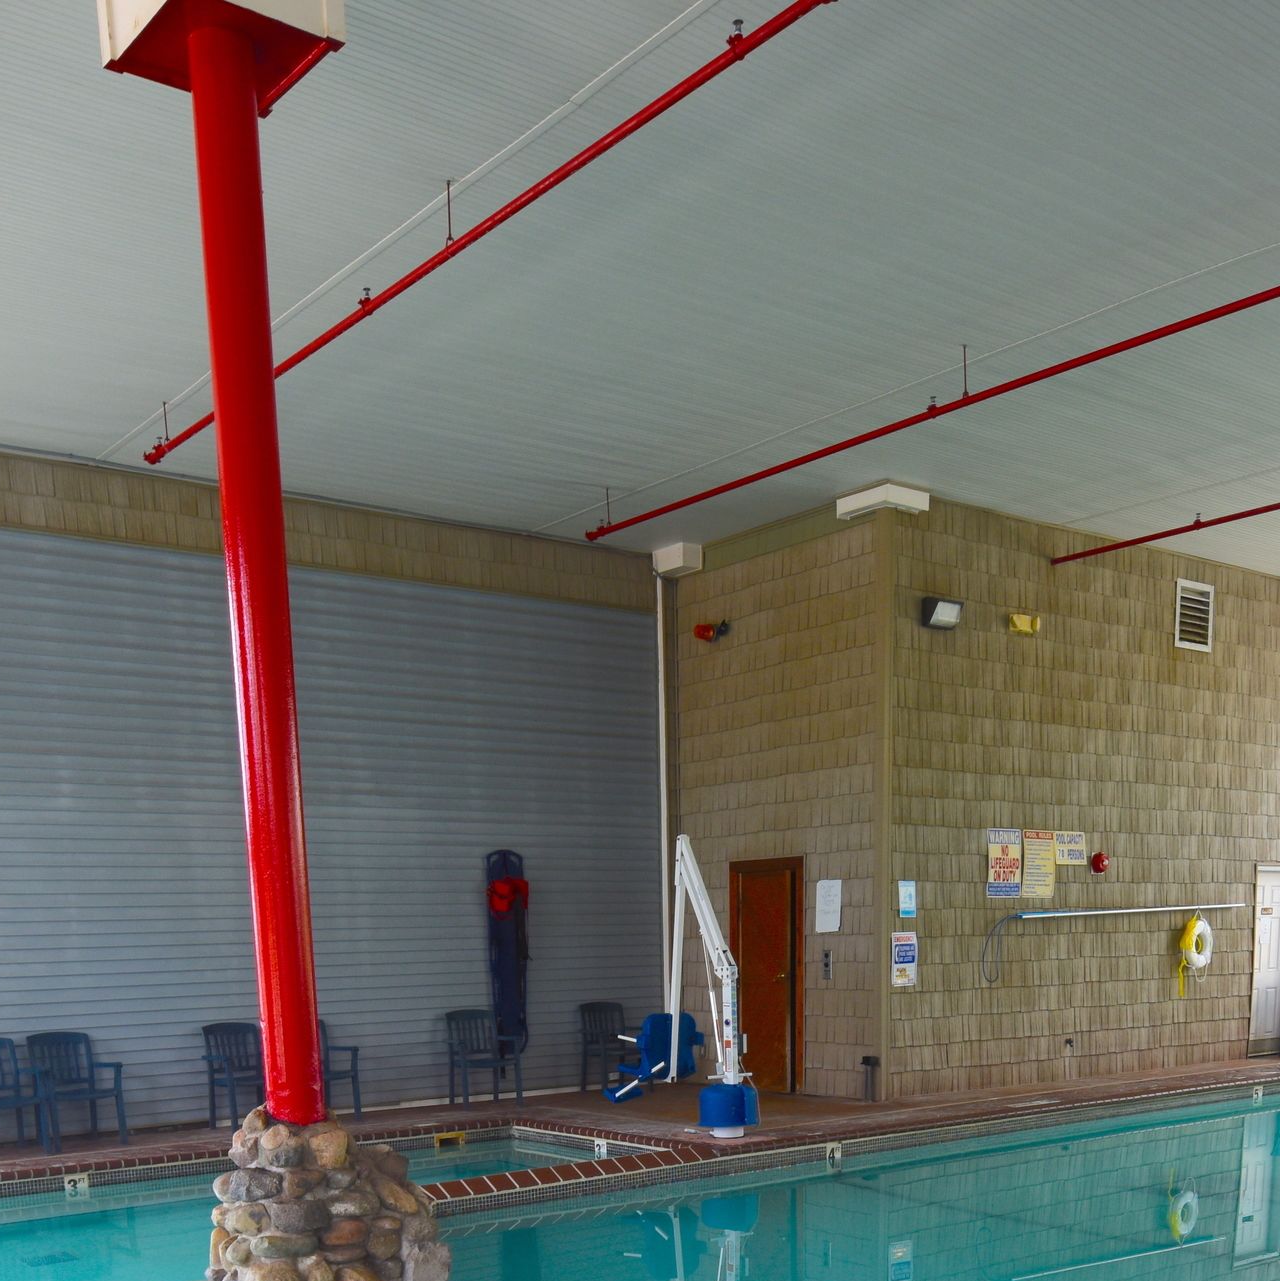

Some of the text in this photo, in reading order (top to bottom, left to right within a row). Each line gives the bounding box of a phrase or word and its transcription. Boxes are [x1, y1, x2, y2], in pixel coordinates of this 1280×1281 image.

[989, 830, 1019, 844] WARNING
[1056, 833, 1084, 844] POOL CAPACITY
[1001, 845, 1009, 856] NO
[1067, 849, 1085, 860] PERSONS
[991, 857, 1019, 869] LIFEGUARD
[993, 870, 1016, 882] ON DUTY
[828, 1147, 835, 1159] 4
